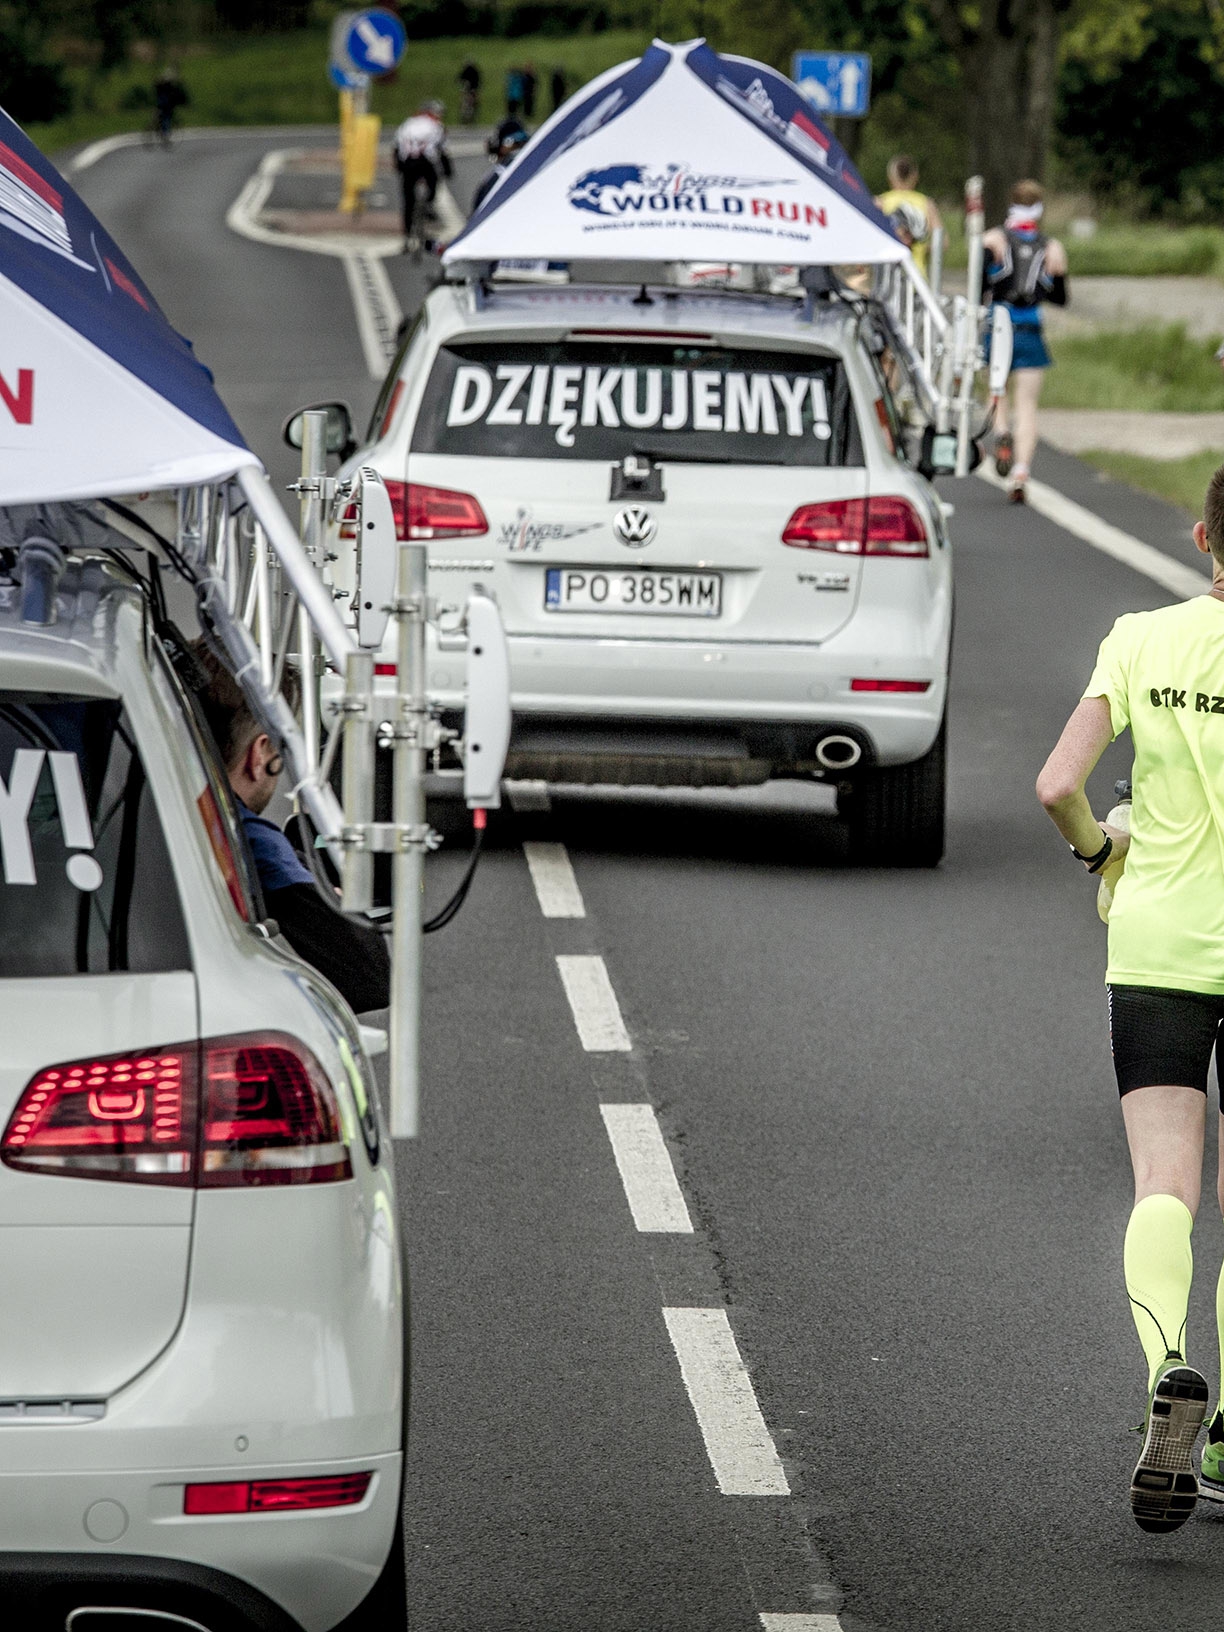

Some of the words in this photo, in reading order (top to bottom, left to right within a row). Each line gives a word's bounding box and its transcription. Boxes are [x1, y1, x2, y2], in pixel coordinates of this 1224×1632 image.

[612, 192, 744, 216] WORLD
[750, 197, 829, 227] RUN
[447, 364, 832, 447] DZIĘKUJEMY!
[566, 575, 609, 602] PO
[621, 575, 715, 606] 385WM
[1150, 687, 1187, 708] OTK
